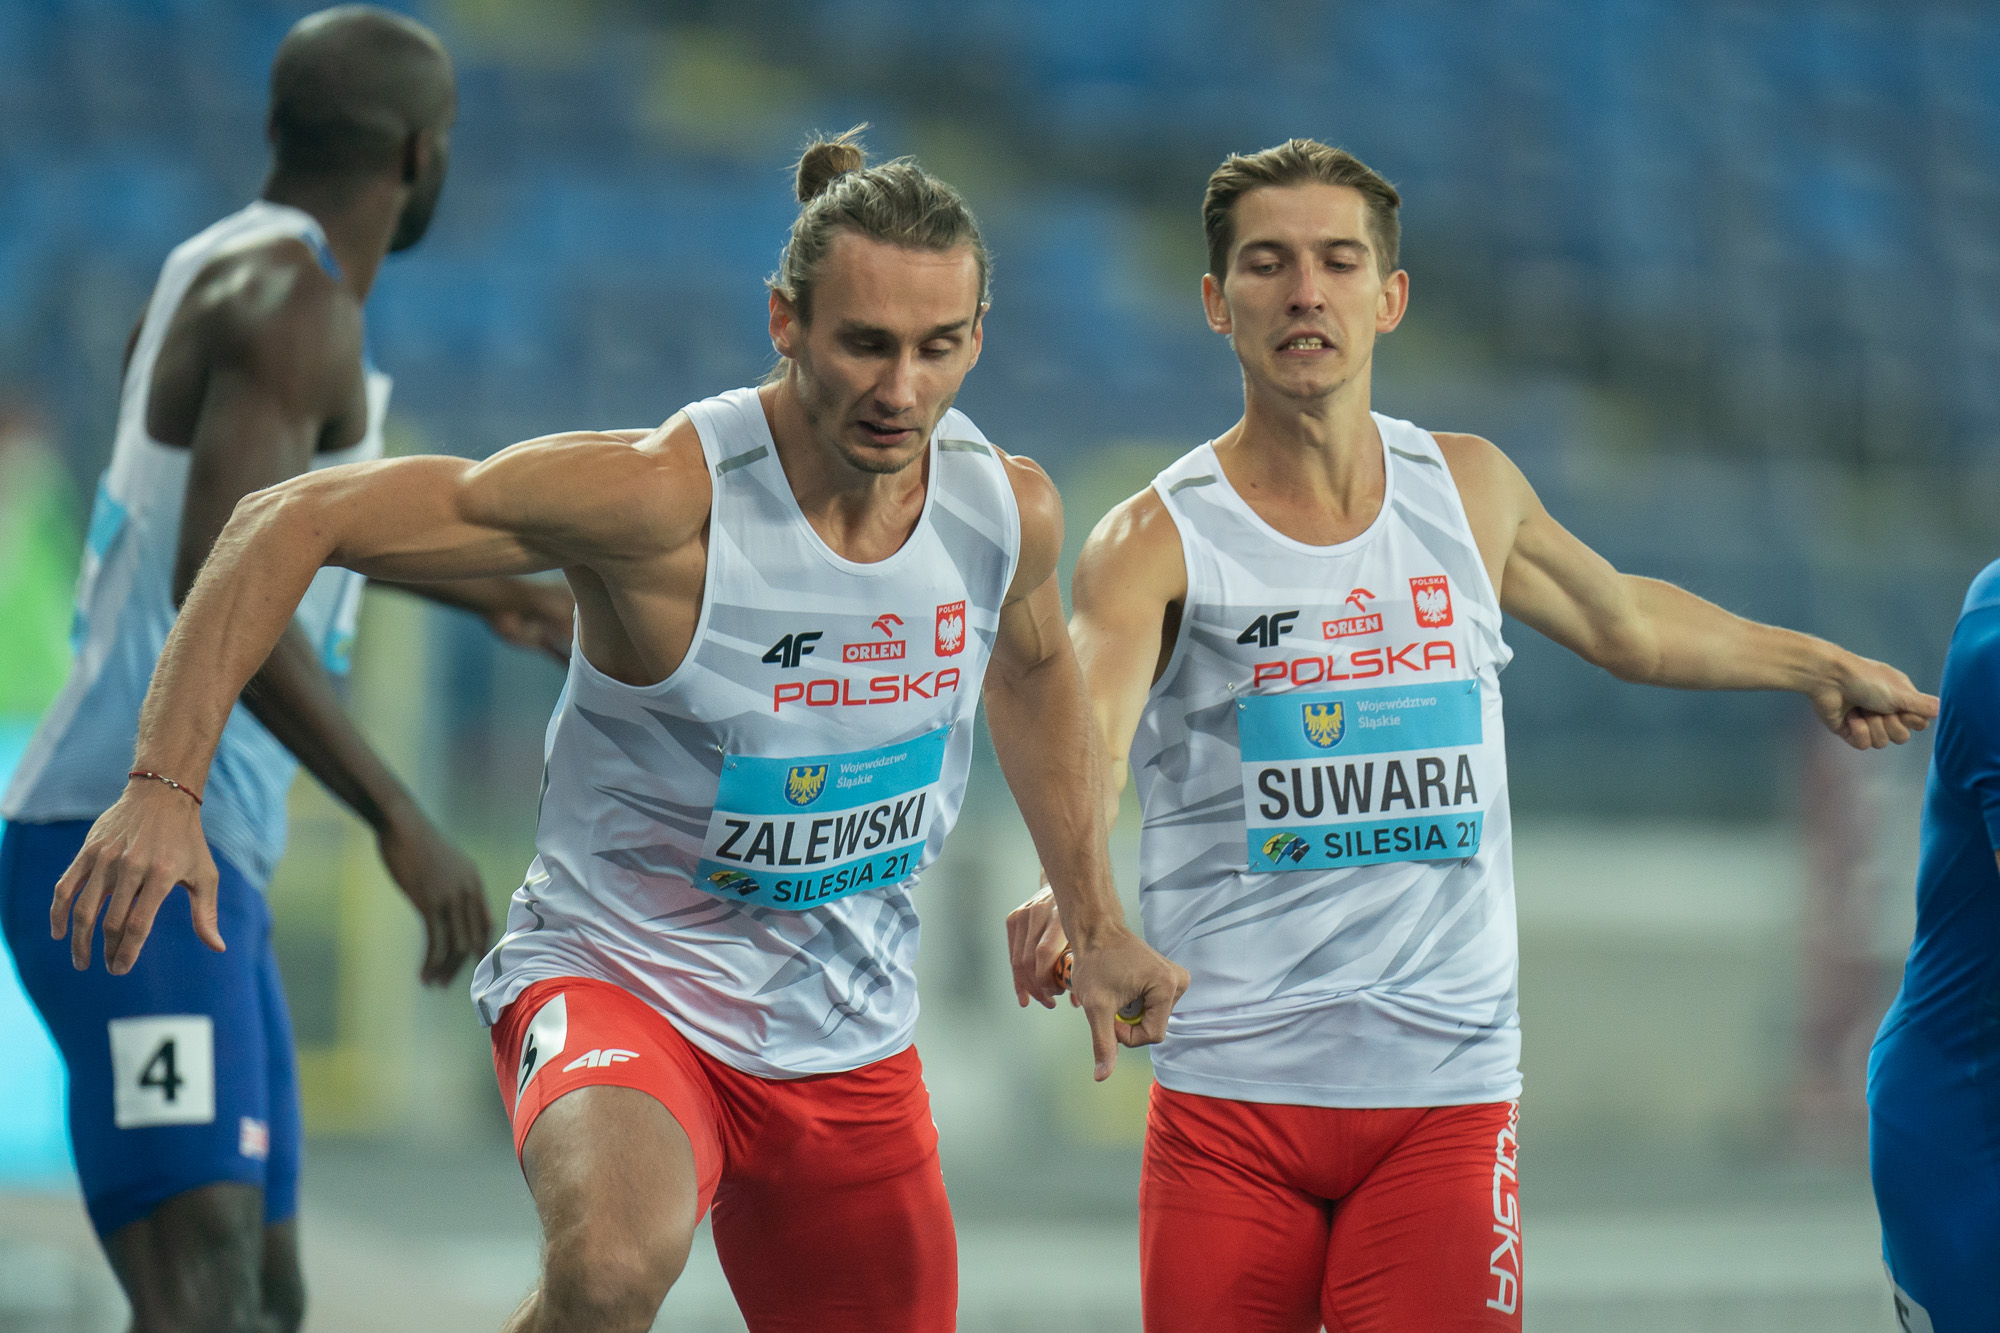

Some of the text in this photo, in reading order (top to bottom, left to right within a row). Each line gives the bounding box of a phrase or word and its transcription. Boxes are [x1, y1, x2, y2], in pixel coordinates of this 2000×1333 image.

[1411, 577, 1446, 586] POLSKA
[938, 602, 964, 614] POLSKA
[1325, 616, 1380, 637] ORLEN
[1237, 610, 1299, 648] 4F
[761, 631, 824, 668] 4F
[845, 643, 902, 661] ORLEN
[1254, 641, 1456, 687] POLSKA
[774, 668, 960, 712] POLSKA
[1356, 696, 1438, 714] Województwo
[1357, 714, 1401, 731] Śląskie
[836, 774, 873, 790] Śląskie
[840, 752, 908, 775] Województwo
[1257, 753, 1479, 821] SUWARA
[715, 792, 927, 866] ZALEWSKI
[1323, 820, 1476, 860] SILESIA 21
[772, 852, 910, 903] SILESIA 21
[138, 1036, 185, 1103] 4
